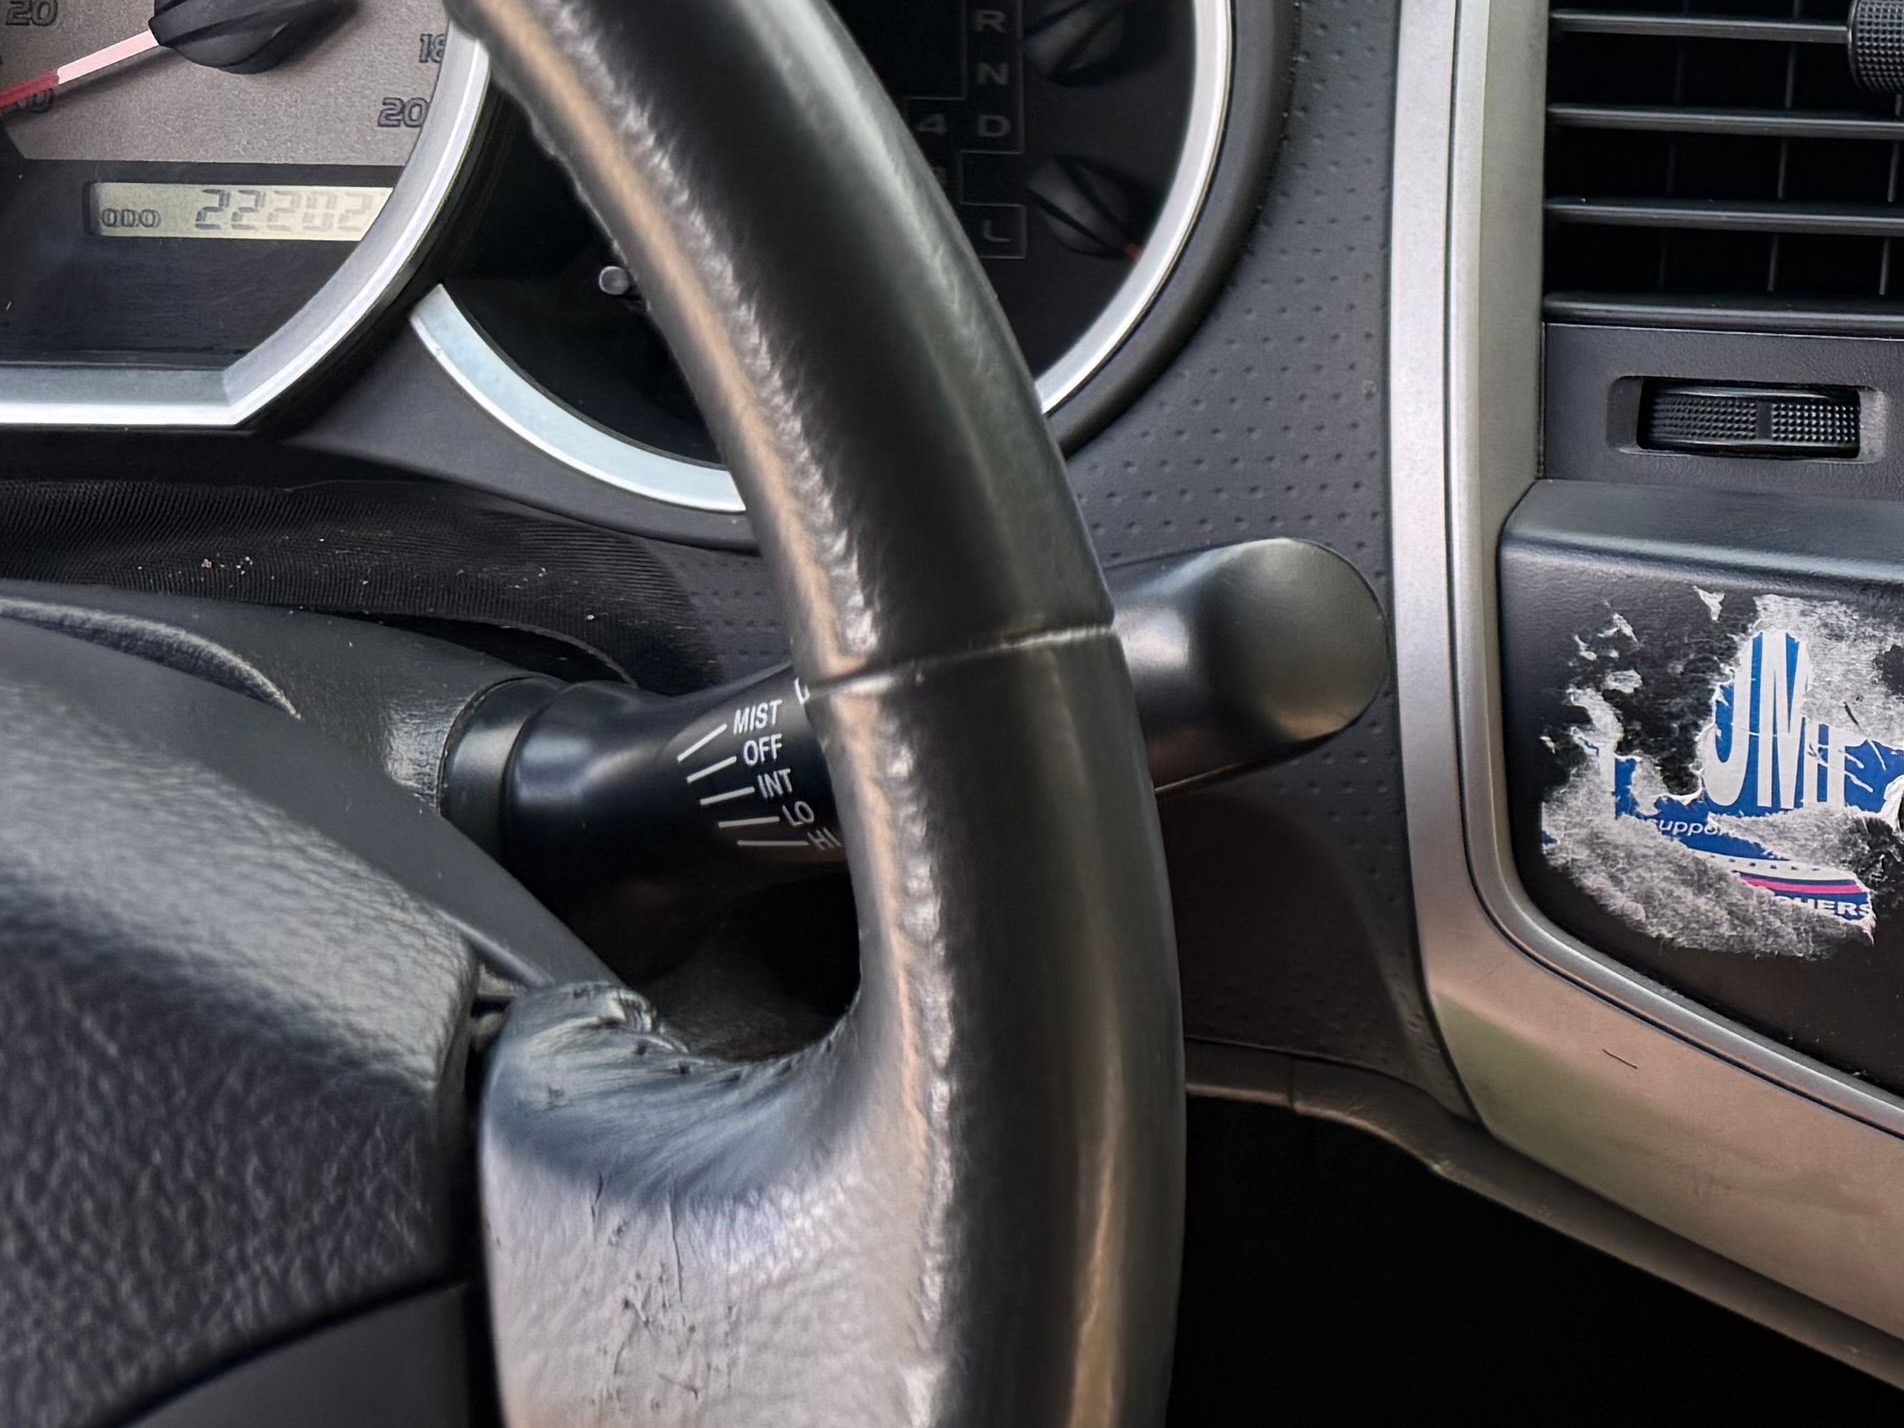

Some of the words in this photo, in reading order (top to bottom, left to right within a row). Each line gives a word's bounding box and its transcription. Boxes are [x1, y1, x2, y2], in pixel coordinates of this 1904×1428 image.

[974, 10, 1006, 32] R
[976, 63, 1009, 86] N
[977, 115, 1010, 138] D
[733, 699, 783, 735] MIST
[743, 733, 783, 766] OFF
[757, 768, 793, 799] INT
[782, 800, 815, 827] LO
[807, 827, 841, 850] HI
